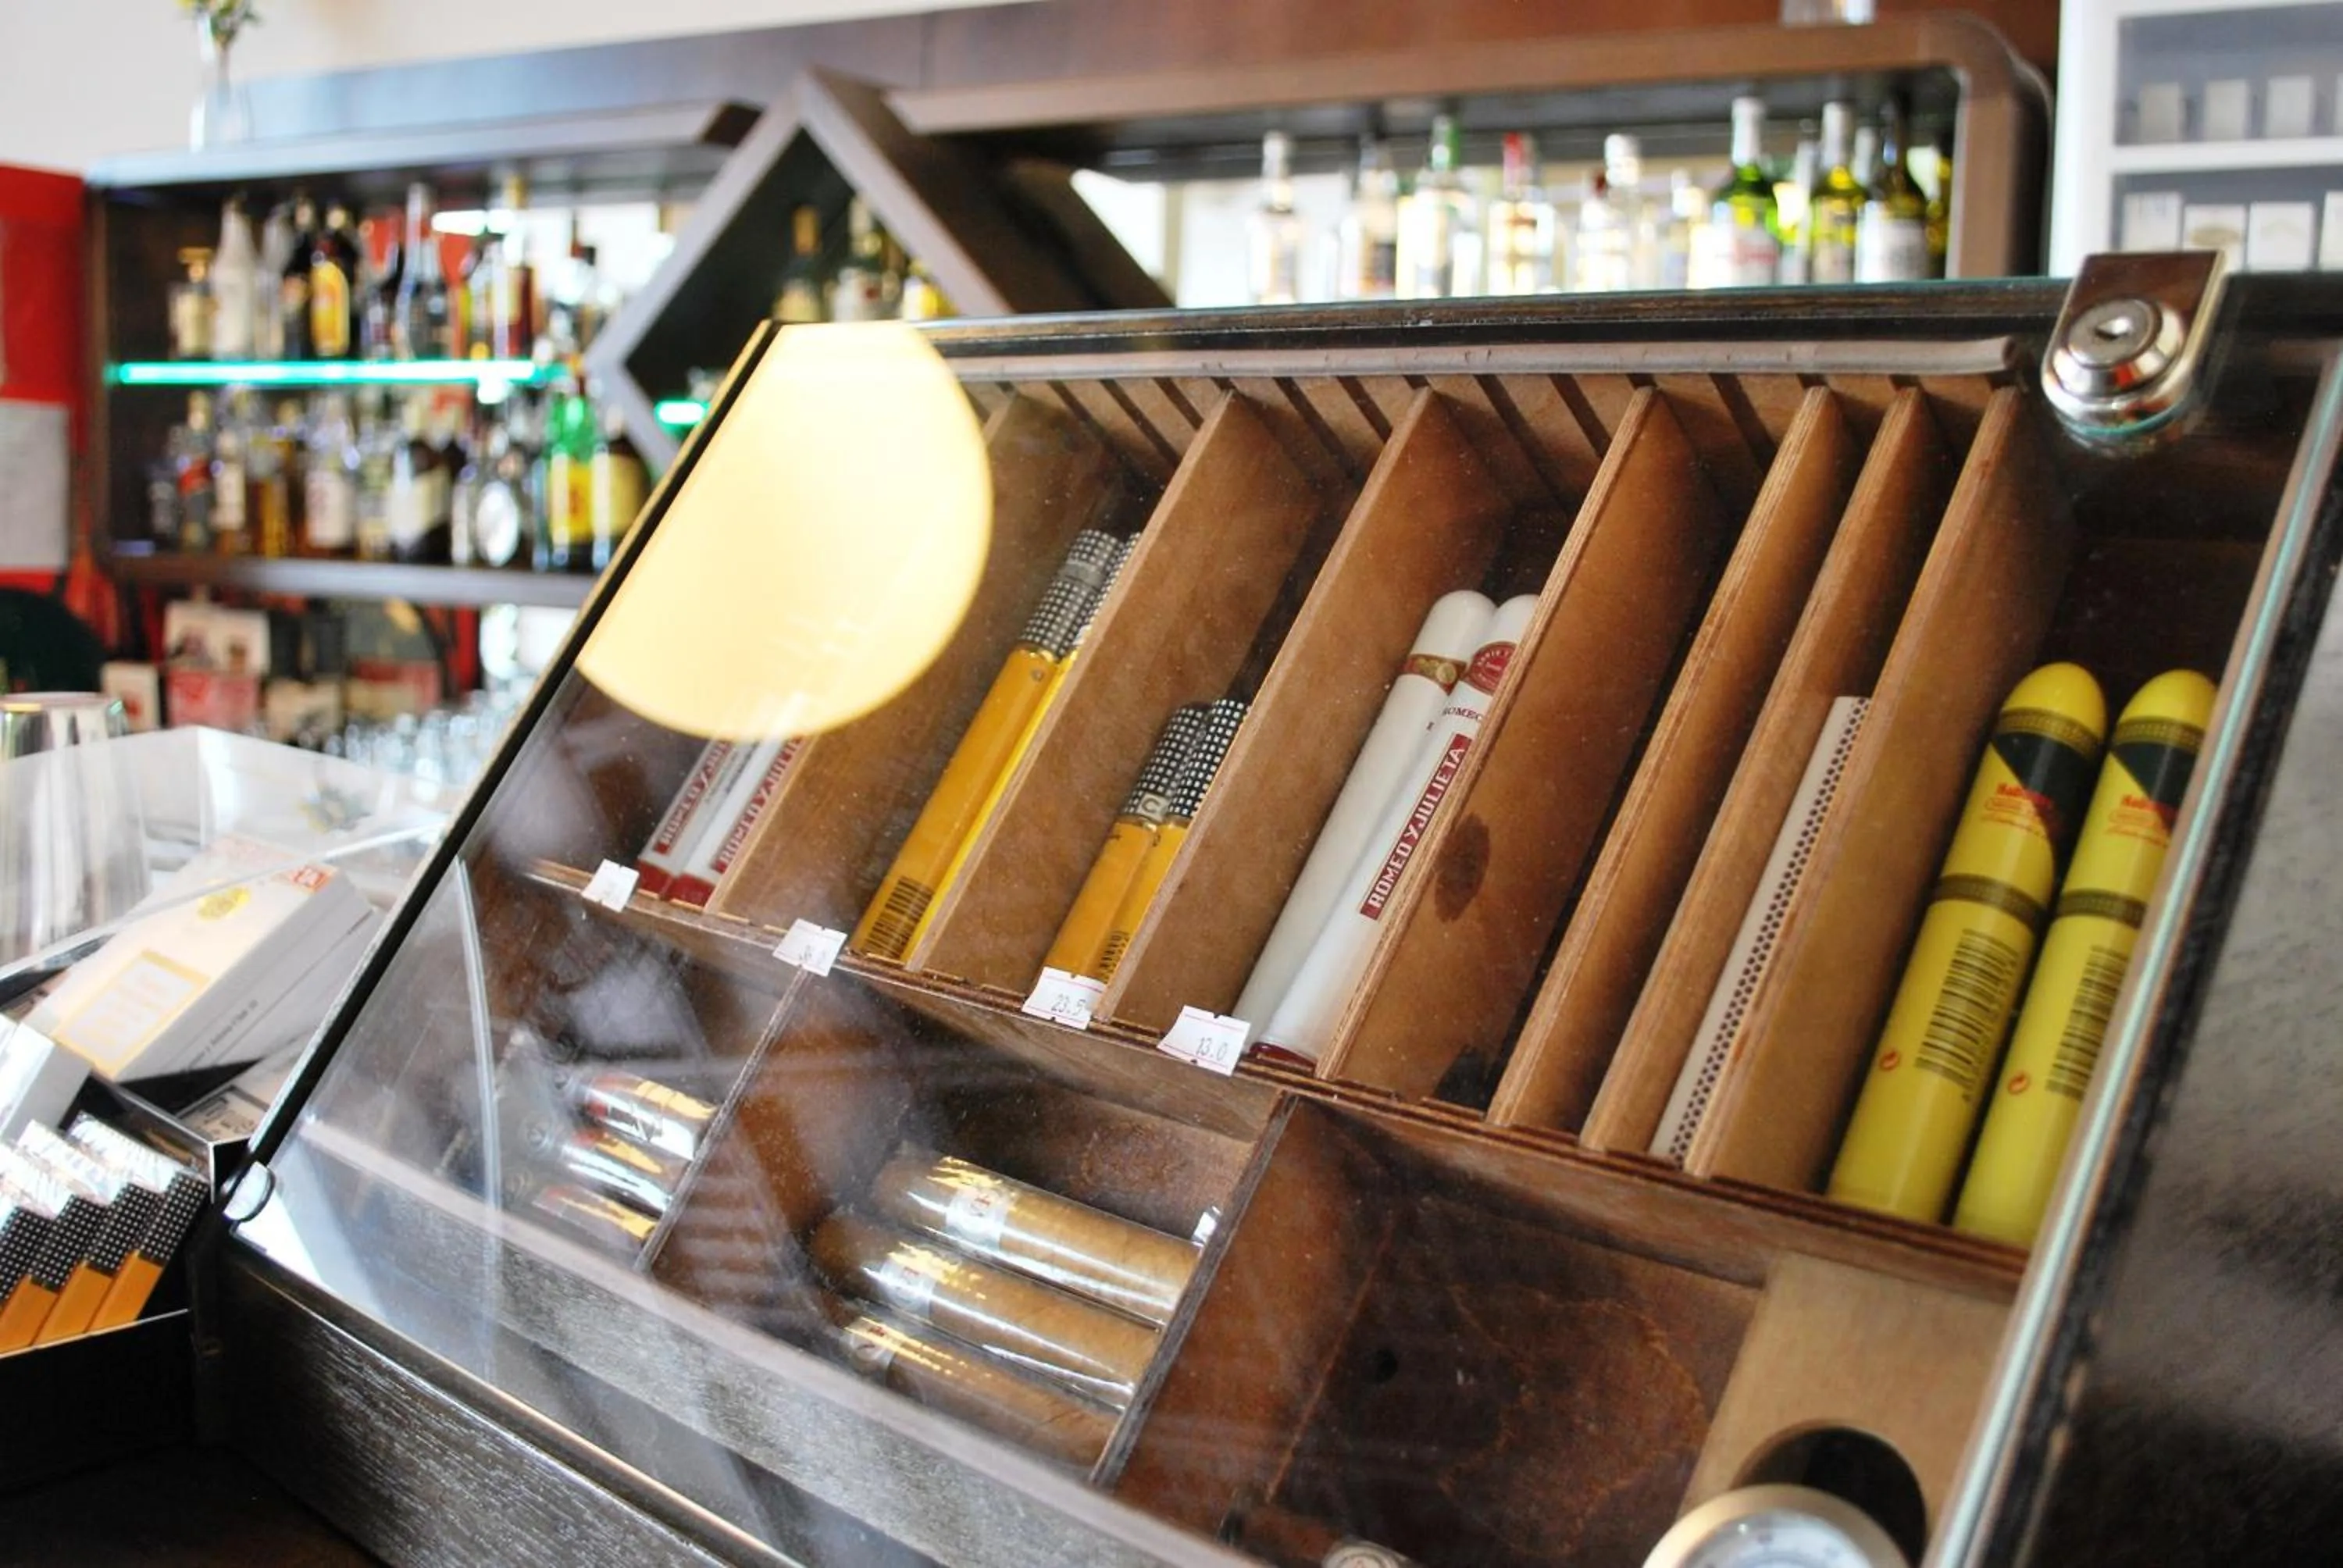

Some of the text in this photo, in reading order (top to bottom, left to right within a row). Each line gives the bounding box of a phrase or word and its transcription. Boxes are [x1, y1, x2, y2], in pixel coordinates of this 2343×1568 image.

[1368, 746, 1465, 908] ROMEO Y JULIETA
[1196, 1036, 1228, 1061] 13.0
